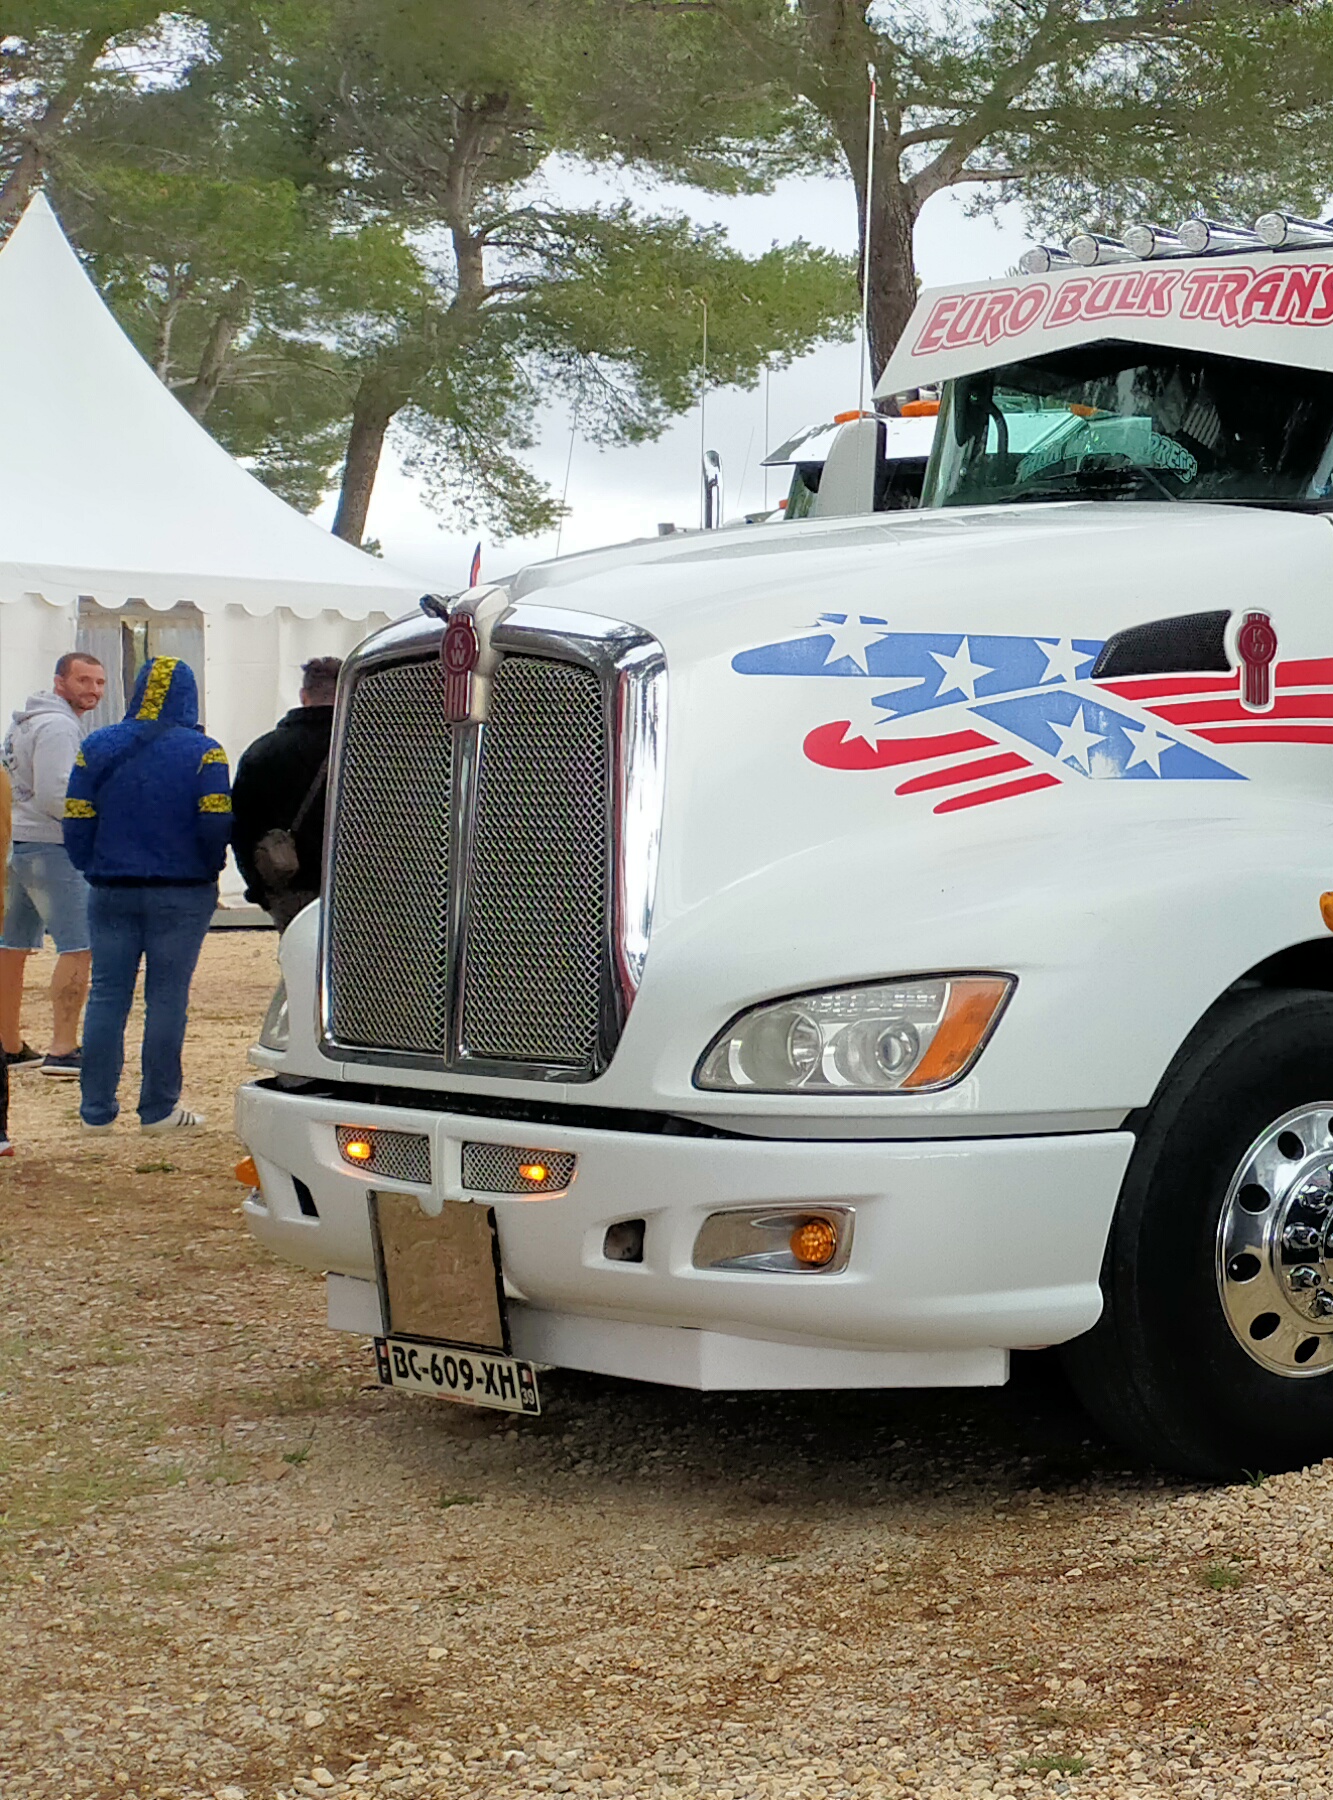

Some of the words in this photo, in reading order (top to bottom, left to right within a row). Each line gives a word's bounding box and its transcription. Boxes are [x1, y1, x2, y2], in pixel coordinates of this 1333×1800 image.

[912, 283, 1047, 356] EURO
[1043, 269, 1181, 328] BULK
[391, 1345, 517, 1400] BC-609-XH
[520, 1388, 535, 1405] 39
